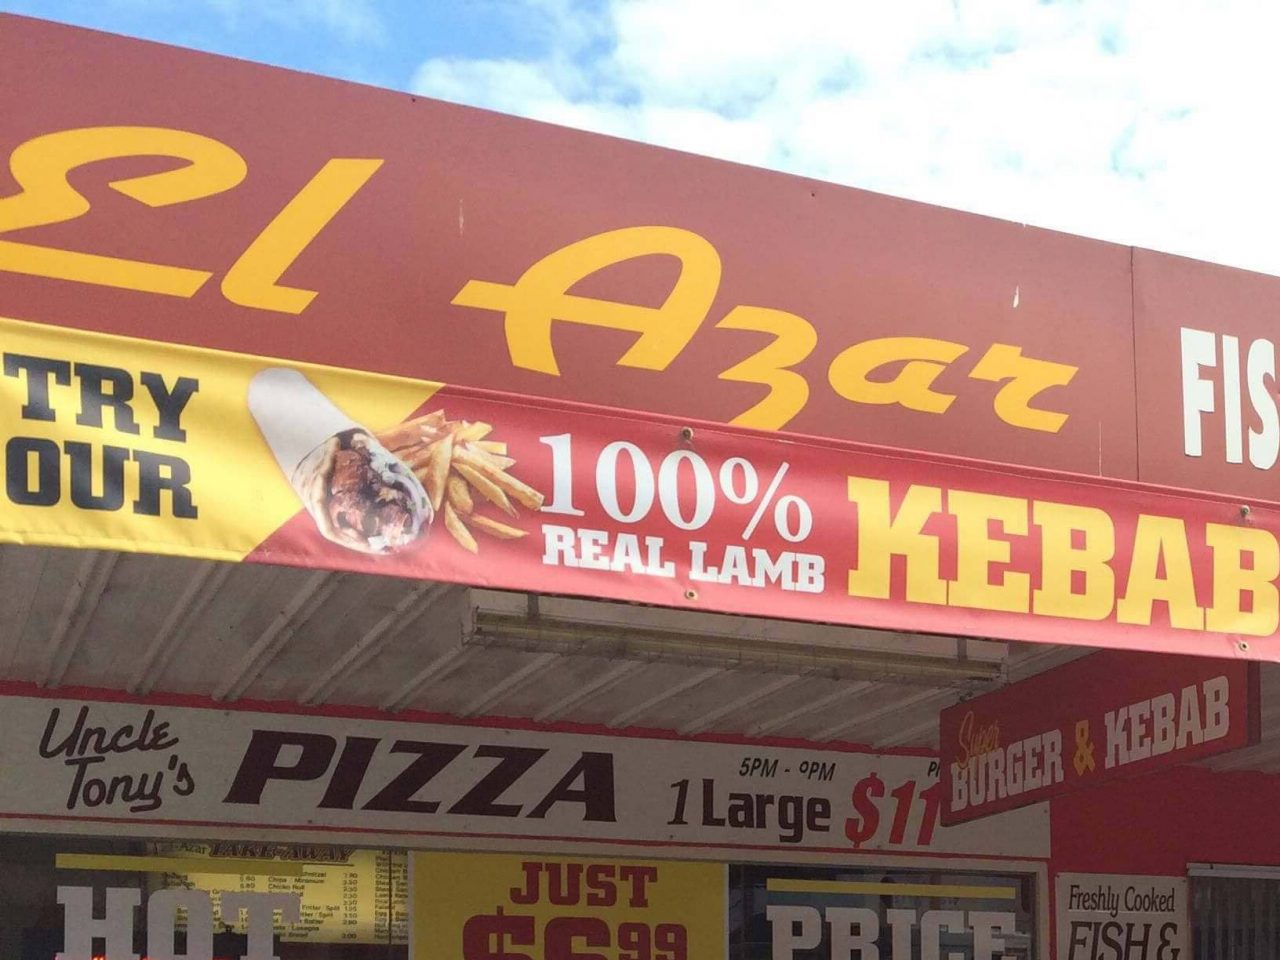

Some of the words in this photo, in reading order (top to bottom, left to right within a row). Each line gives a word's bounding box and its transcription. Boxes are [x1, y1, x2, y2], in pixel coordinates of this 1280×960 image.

[0, 126, 384, 314] El
[451, 226, 1079, 432] Azar
[3, 353, 199, 443] TRY
[6, 437, 198, 520] OUR
[539, 433, 813, 543] 100%
[542, 525, 677, 578] REAL
[689, 540, 825, 594] LAMB
[847, 476, 1280, 636] KEBAB
[38, 706, 179, 759] Uncle
[739, 757, 779, 778] 5PM
[950, 727, 1065, 813] BURGER
[1072, 719, 1095, 776] &
[1103, 675, 1230, 769] KEBAB
[64, 754, 195, 813] Tony's
[223, 729, 617, 823] PIZZA
[667, 779, 689, 825] 1
[701, 778, 831, 842] Large
[510, 862, 658, 907] JUST
[1068, 885, 1119, 918] Freshly
[1125, 886, 1175, 912] Cooked
